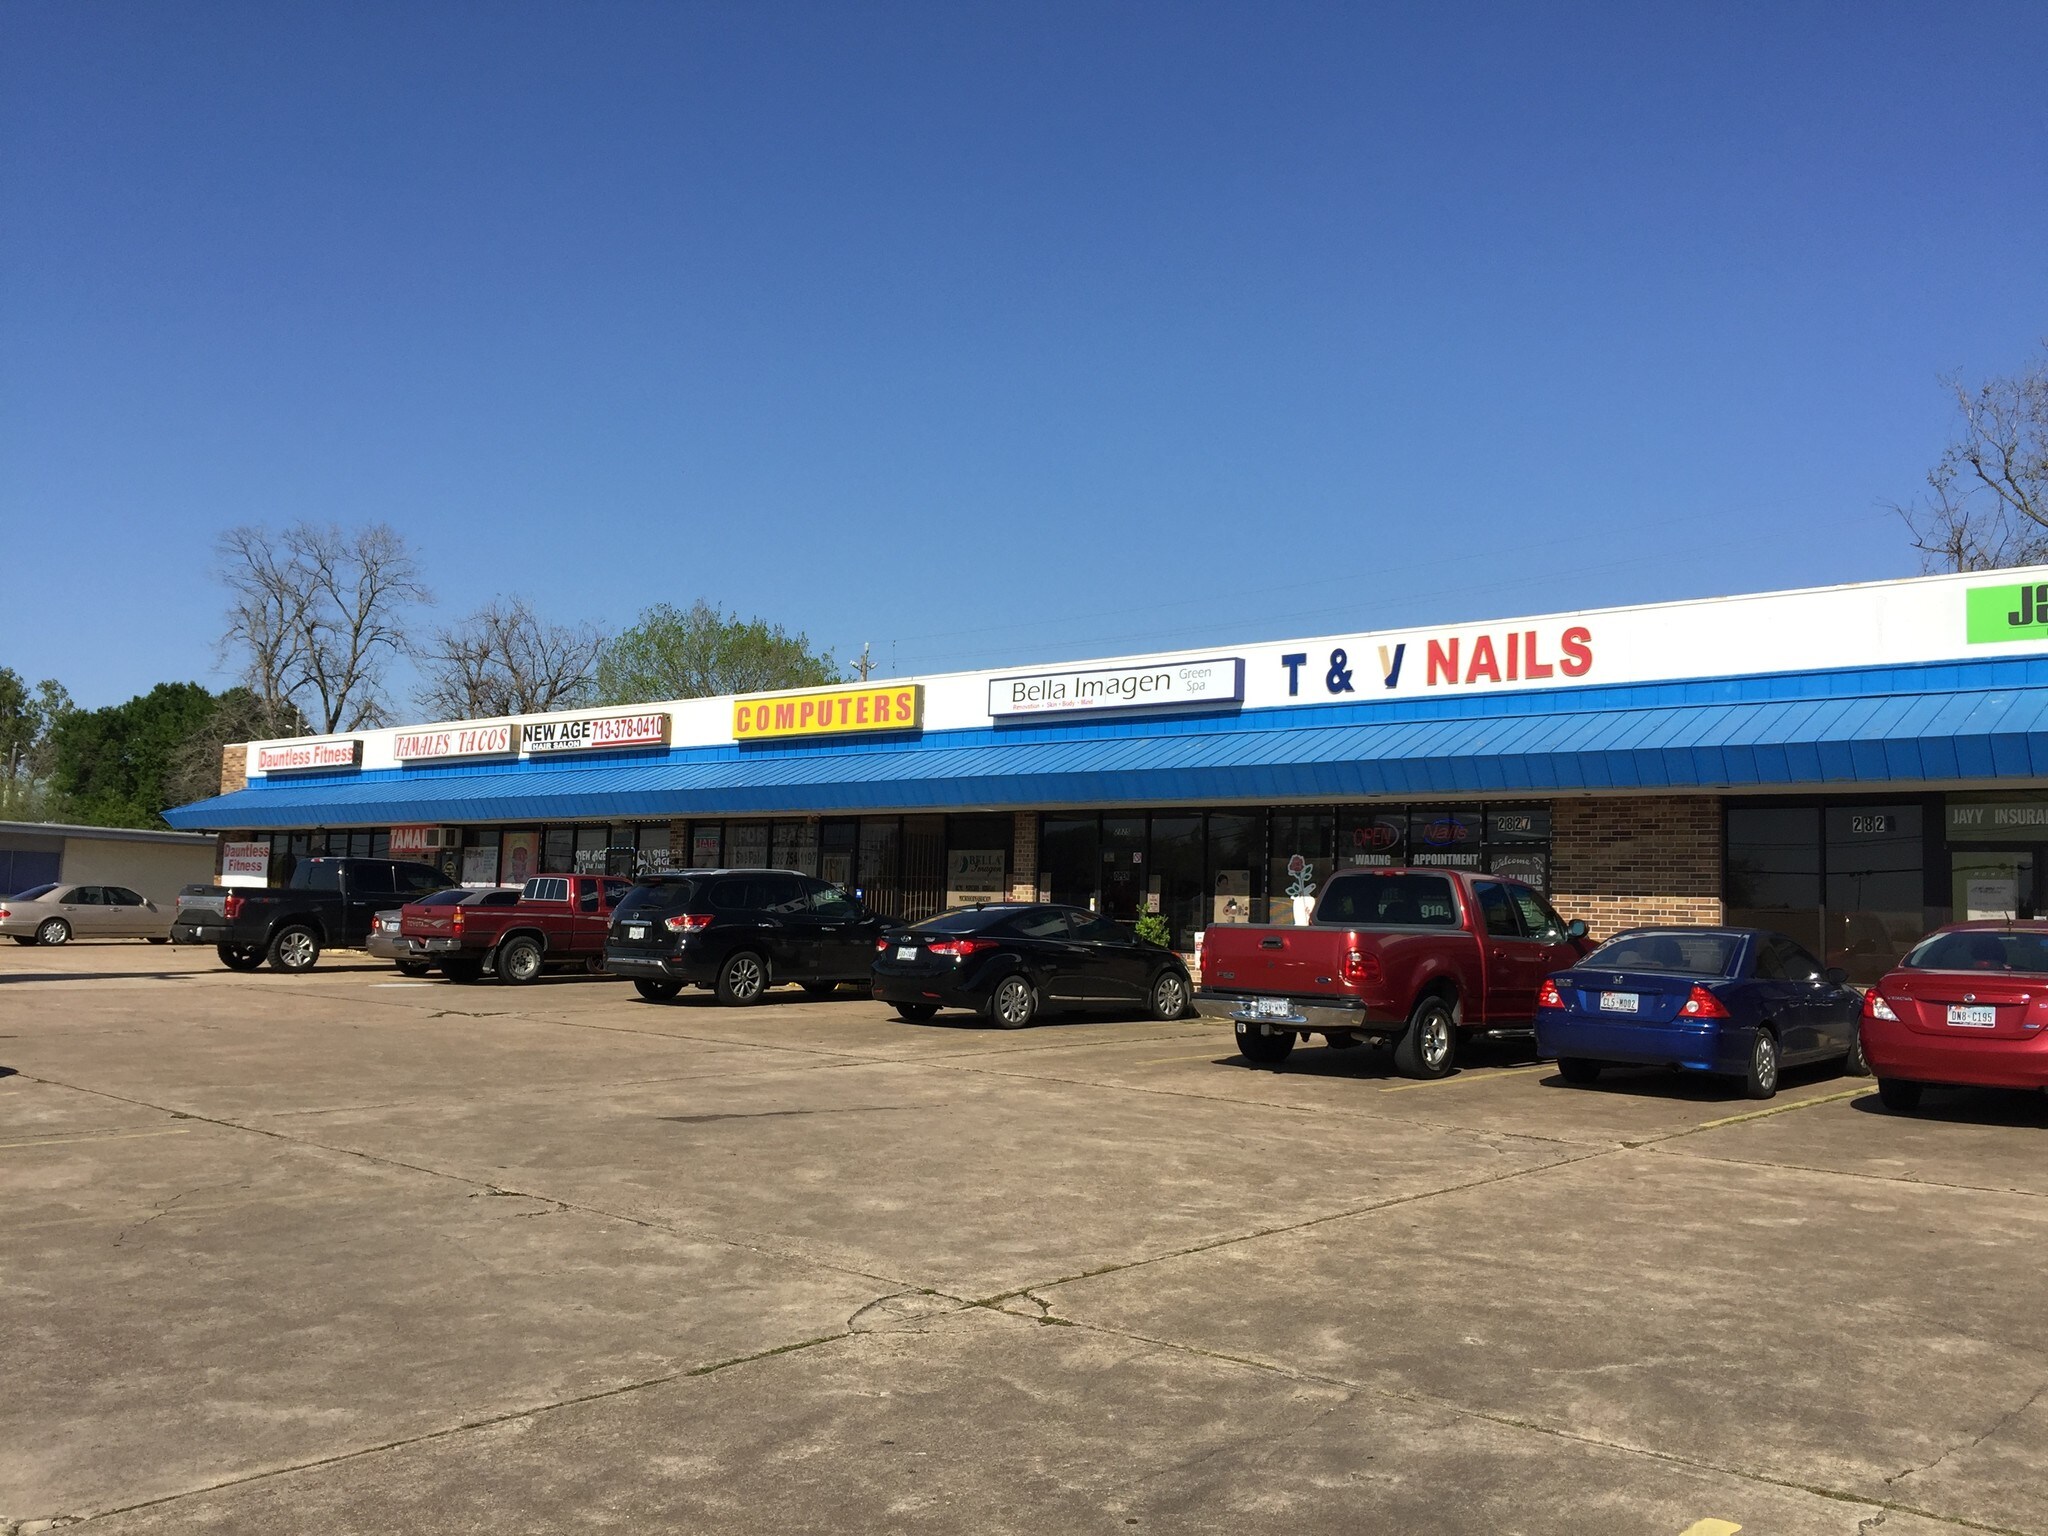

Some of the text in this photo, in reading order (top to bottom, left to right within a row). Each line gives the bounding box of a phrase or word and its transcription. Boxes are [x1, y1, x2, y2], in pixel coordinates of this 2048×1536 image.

[1282, 626, 1593, 697] T & V NAILS
[1179, 667, 1212, 680] Green
[1012, 673, 1171, 703] Bella Imagen
[1186, 680, 1206, 694] Spa
[736, 692, 912, 733] COMPUTERS
[523, 715, 663, 742] NEW AGE 713-378-0410
[396, 727, 508, 757] TAMALES TACOS
[553, 740, 579, 748] SALON
[259, 745, 354, 769] Dauntless Fitness
[1498, 816, 1531, 831] 2827
[1952, 808, 1984, 824] JAYY
[1853, 816, 1885, 832] 282
[1353, 828, 1391, 847] OPEN
[1423, 824, 1469, 841] Nails
[224, 844, 269, 857] Dauntless
[228, 860, 262, 871] Fitness
[969, 855, 1002, 865] BELLA
[1355, 854, 1391, 866] WAXING
[1413, 853, 1479, 866] APPOINTMENT
[970, 865, 1002, 878] Imagen
